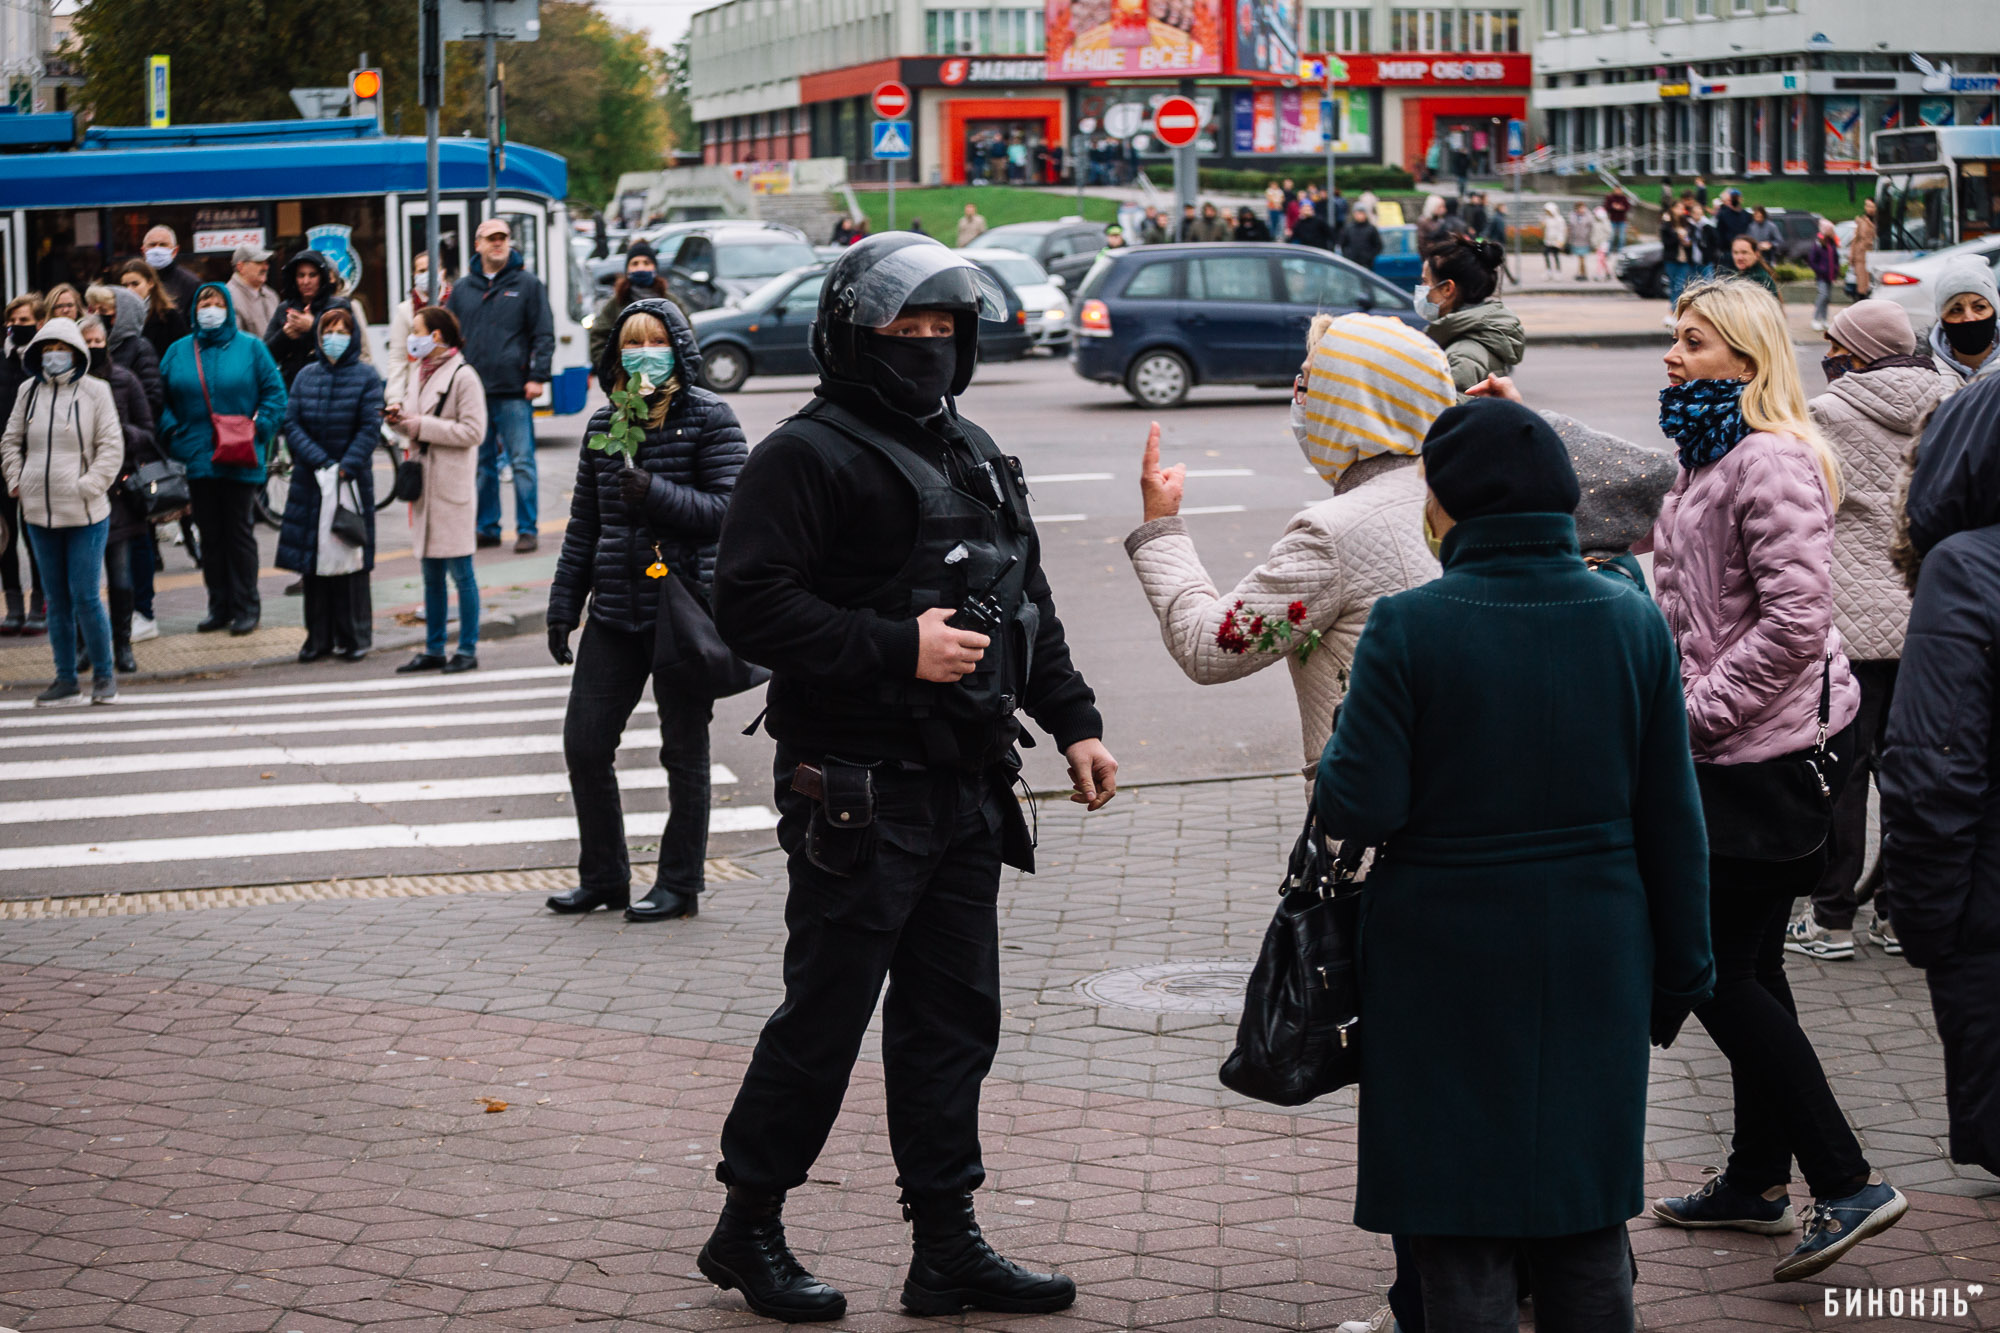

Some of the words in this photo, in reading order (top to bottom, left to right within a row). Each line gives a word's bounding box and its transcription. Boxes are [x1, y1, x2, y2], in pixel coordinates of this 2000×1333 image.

[1062, 48, 1128, 72] НАШЕ
[1378, 61, 1429, 79] МИР
[1431, 61, 1505, 80] ОБОЕВ
[1951, 77, 2000, 91] ЦЕНТР
